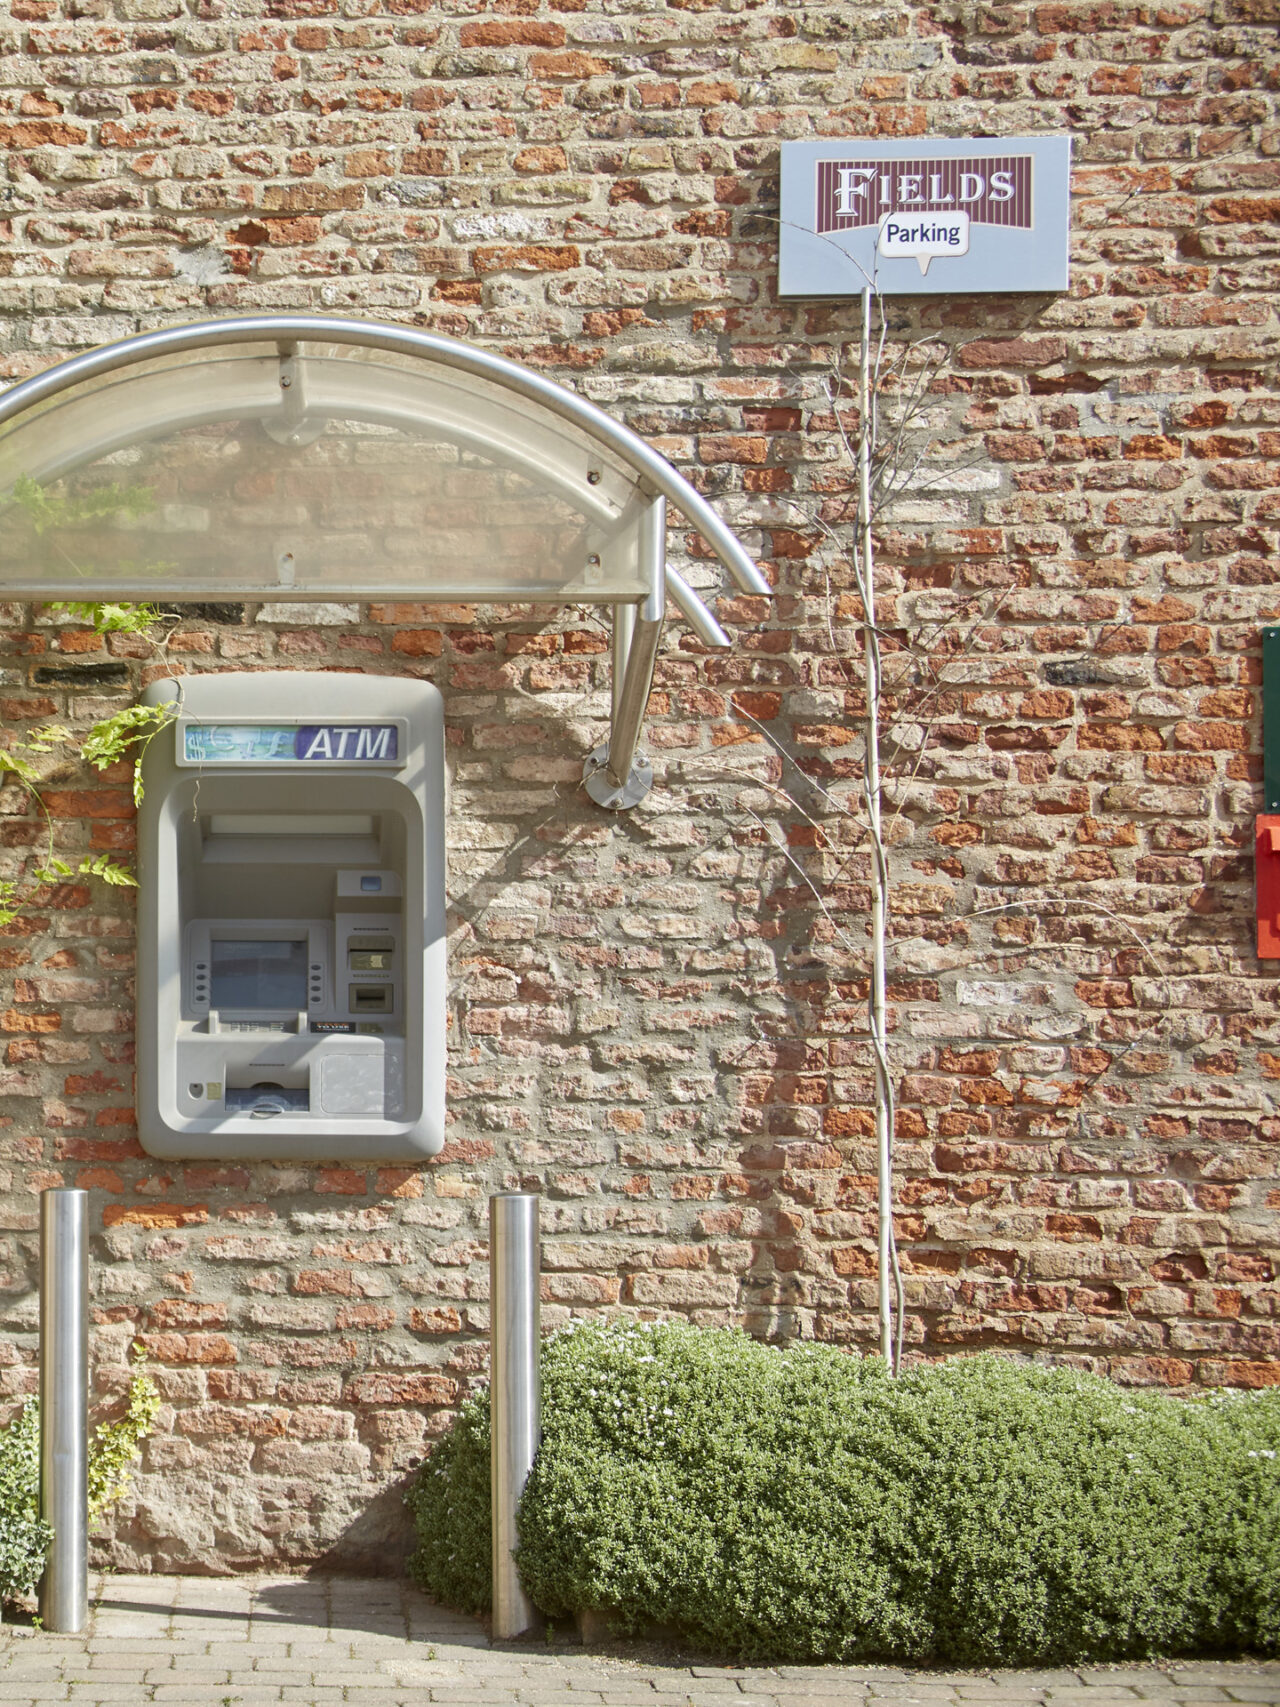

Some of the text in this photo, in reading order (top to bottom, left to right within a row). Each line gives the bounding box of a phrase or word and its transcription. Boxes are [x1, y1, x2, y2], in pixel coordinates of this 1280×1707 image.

[834, 168, 1015, 217] FIELDS
[887, 223, 961, 245] Parking
[304, 728, 391, 759] ATM
